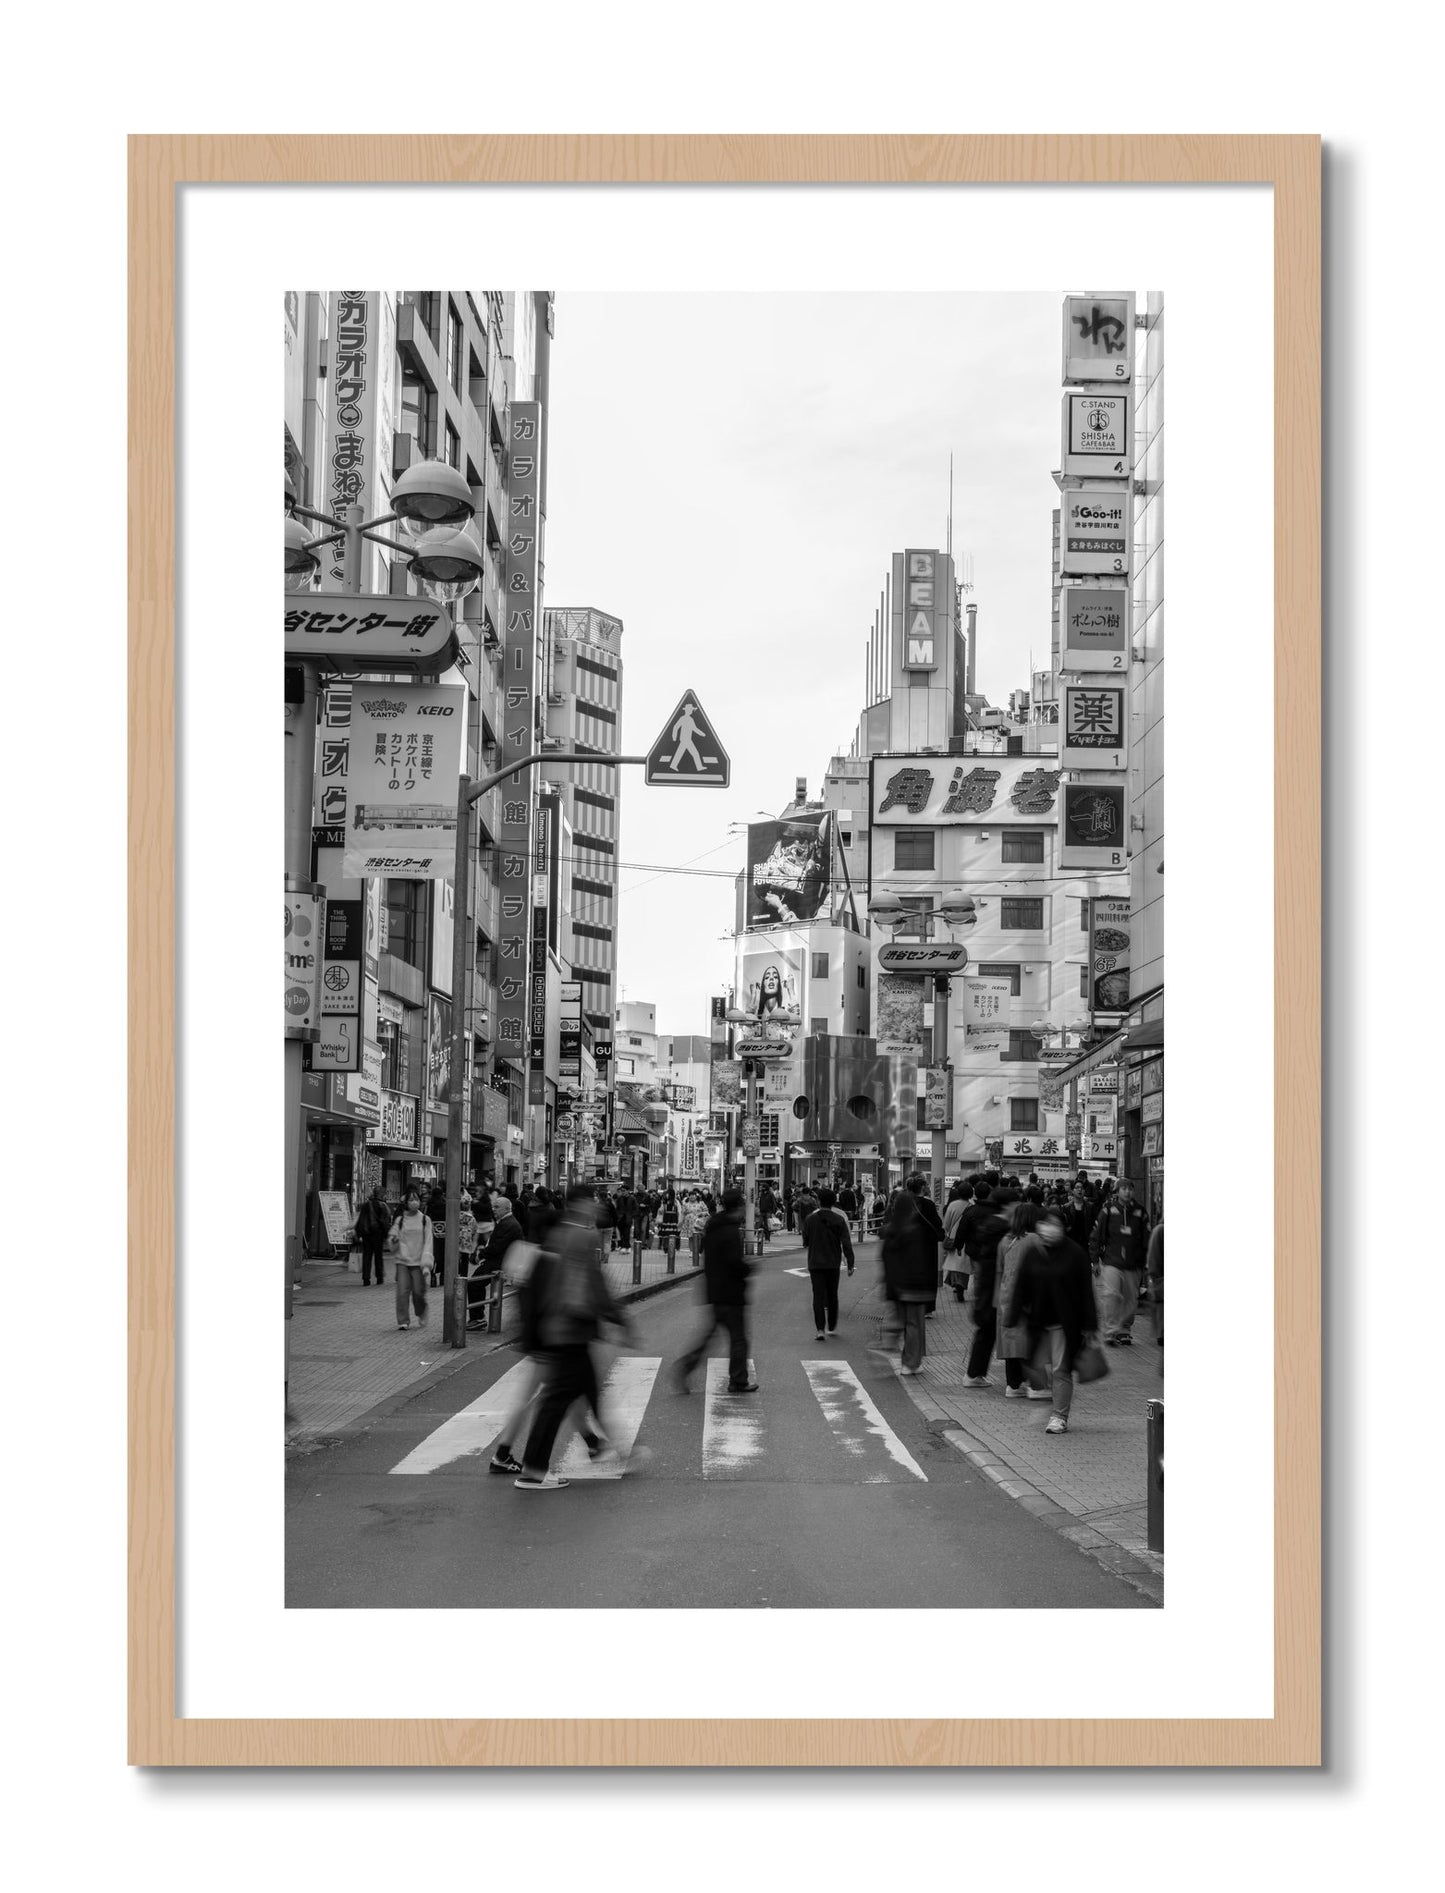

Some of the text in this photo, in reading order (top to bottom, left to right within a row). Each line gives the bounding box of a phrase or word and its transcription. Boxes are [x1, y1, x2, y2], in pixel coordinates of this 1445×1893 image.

[336, 300, 368, 405] カラオケ
[1115, 365, 1125, 376] 5
[1081, 400, 1116, 409] C.STAND
[1081, 432, 1116, 440] SHISHA
[1080, 506, 1122, 519] Goo-it!
[1113, 559, 1123, 571] 3
[909, 553, 936, 664] BEAM
[1113, 656, 1123, 668] 2
[417, 705, 454, 716] KEIO
[1073, 693, 1113, 732] 薬
[375, 733, 387, 767] 冒険へ
[388, 733, 403, 790] カントーの
[421, 734, 434, 780] 京王線で
[1112, 754, 1119, 766] 1
[878, 766, 1062, 814] 角海老
[364, 858, 433, 868] 渋谷センター街
[1111, 853, 1121, 865] B
[884, 950, 962, 961] 渋谷センター街
[320, 1044, 346, 1053] Whisky
[596, 1047, 611, 1055] GU
